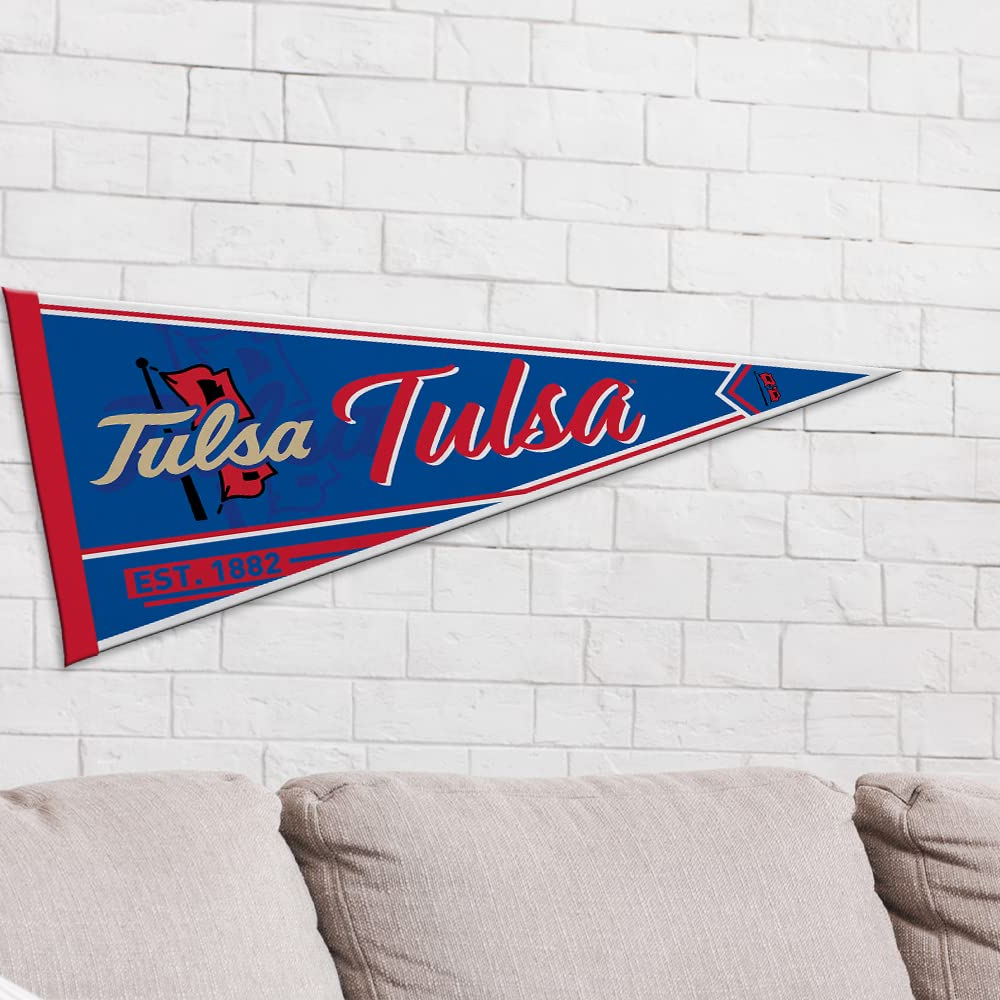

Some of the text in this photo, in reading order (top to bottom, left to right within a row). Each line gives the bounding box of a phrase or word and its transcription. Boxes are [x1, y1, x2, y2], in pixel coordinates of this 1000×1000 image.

[89, 402, 314, 486] Tulsa
[331, 358, 647, 487] Tulsa
[133, 552, 283, 594] EST. 1882
